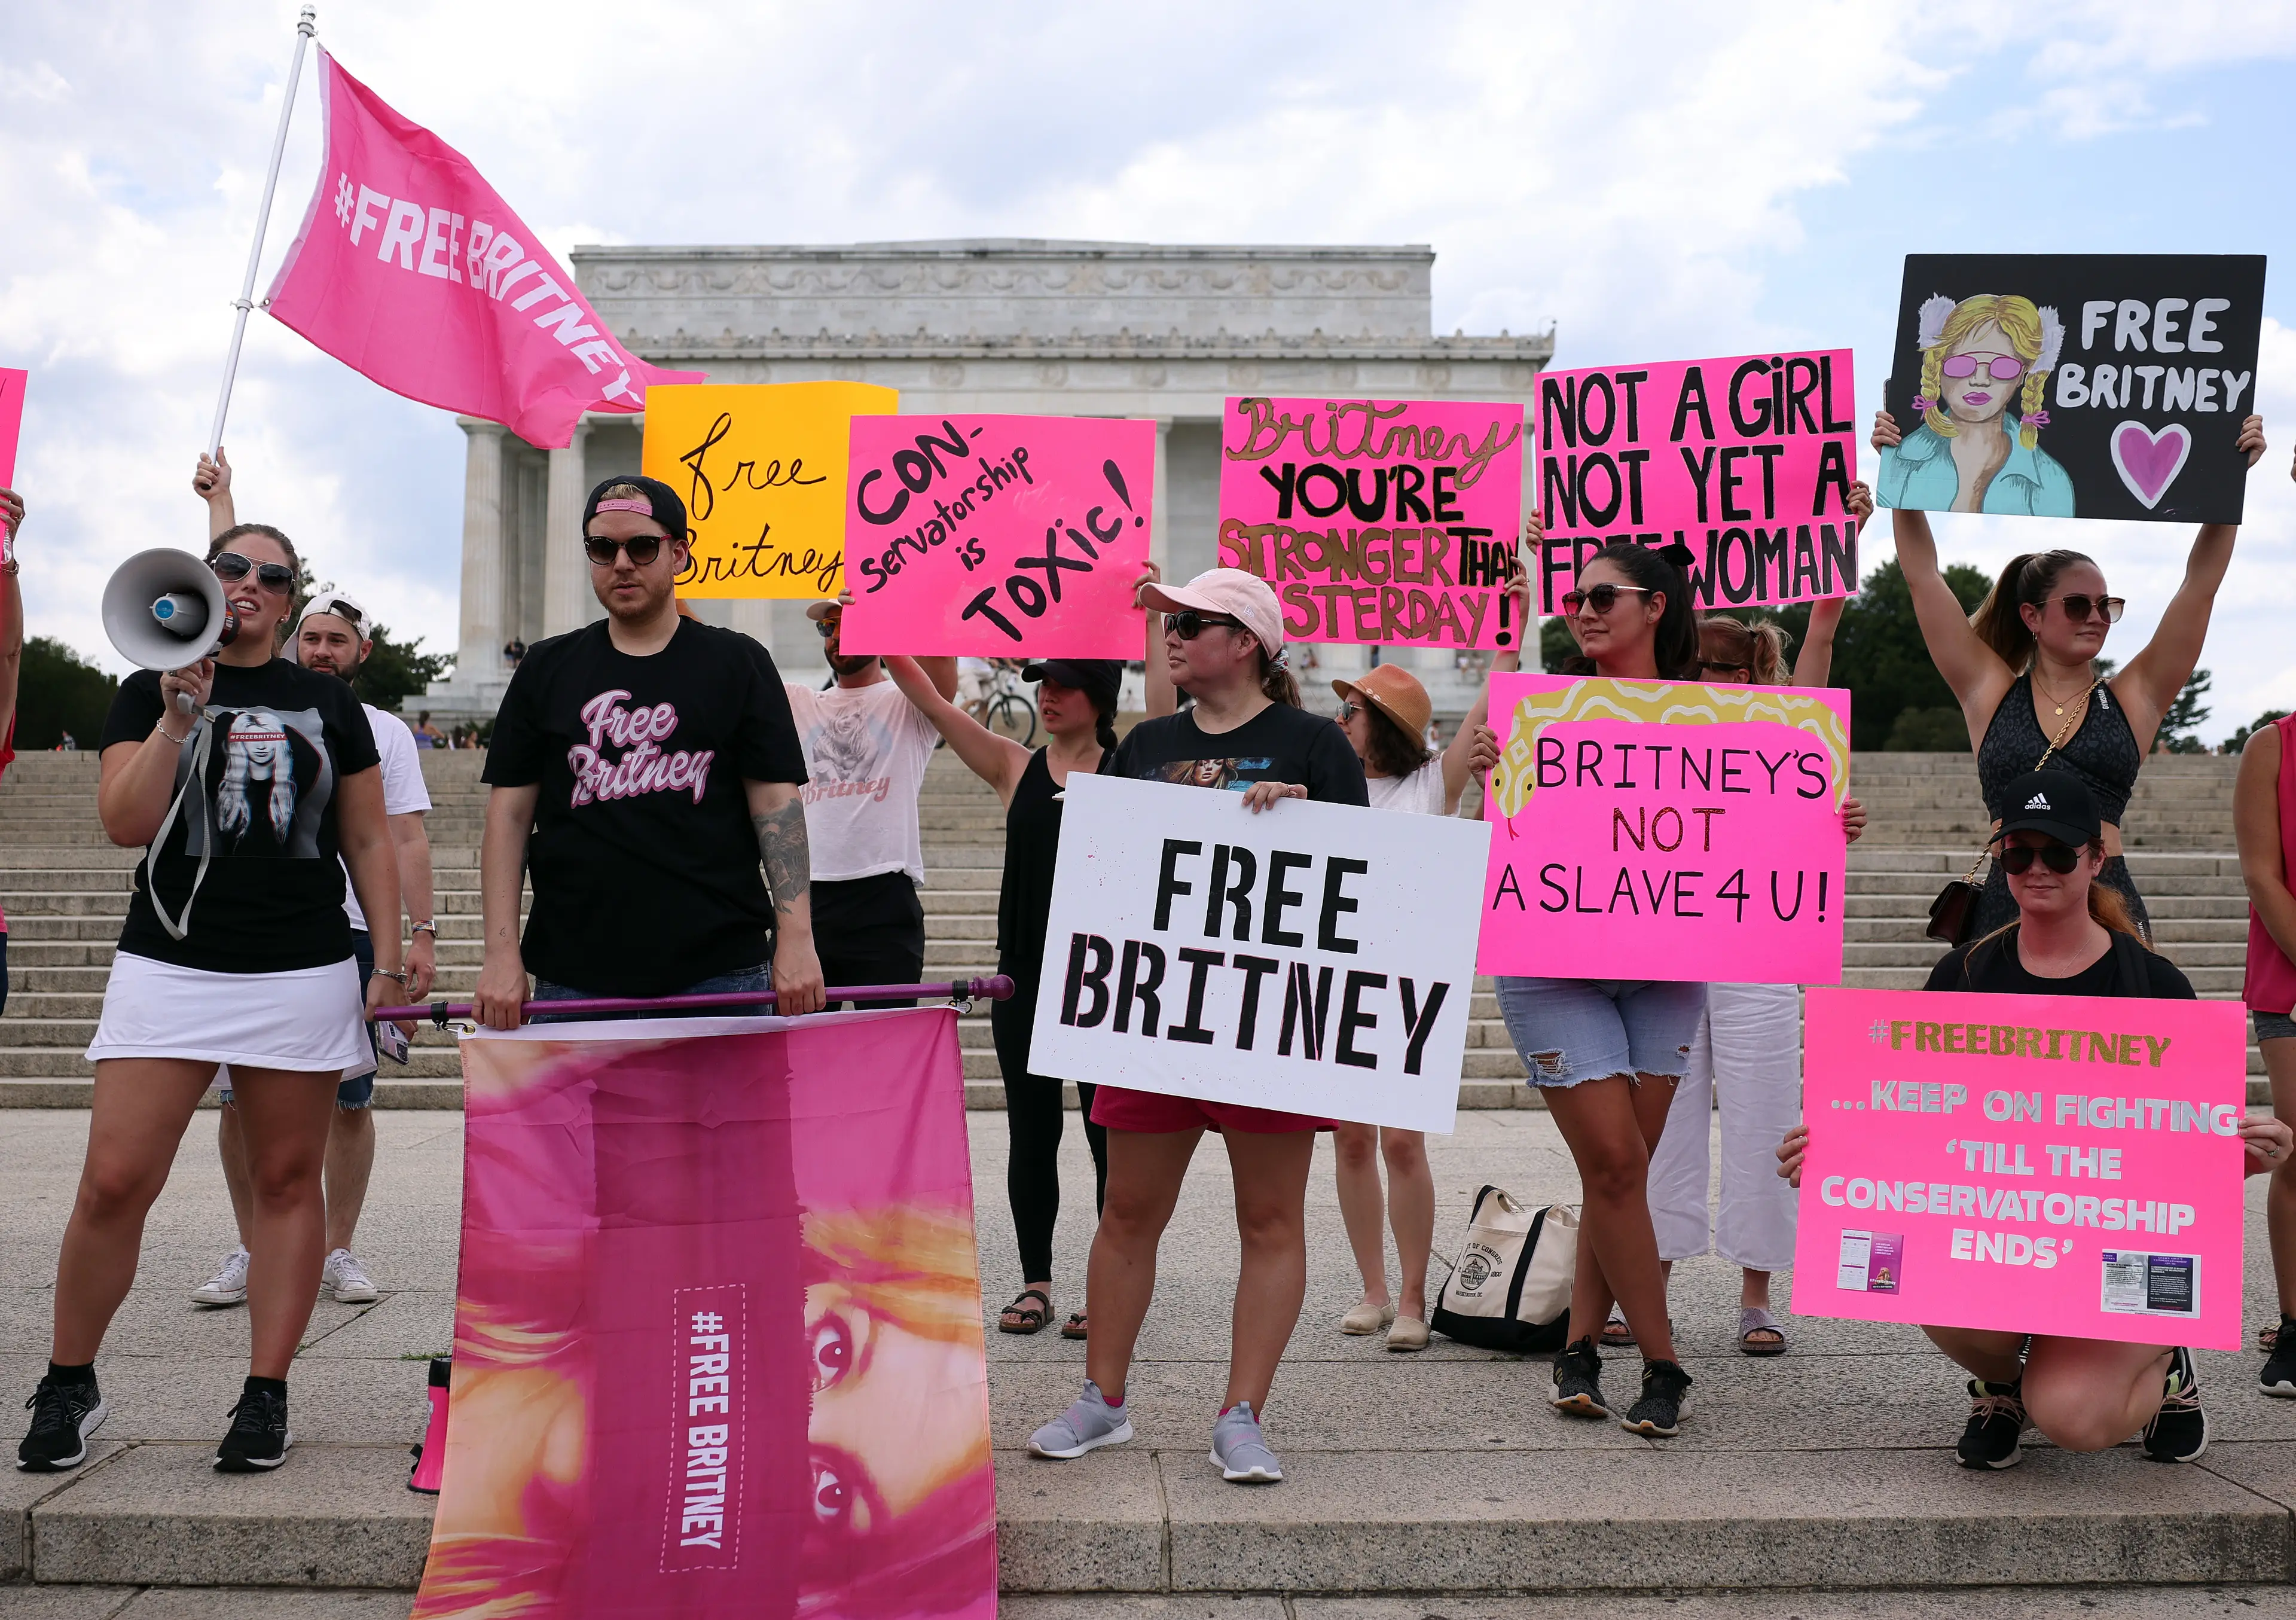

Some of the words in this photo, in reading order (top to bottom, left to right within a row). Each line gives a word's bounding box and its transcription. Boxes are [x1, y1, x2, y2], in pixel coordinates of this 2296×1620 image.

[2081, 298, 2231, 353] FREE
[1541, 370, 1648, 450] NOT
[1669, 366, 1716, 442] A
[2056, 363, 2251, 412] BRITNEY
[1259, 463, 1465, 523] YOU'RE
[1543, 450, 1650, 530] NOT
[1679, 444, 1784, 523] YET
[1812, 441, 1859, 517] A
[955, 537, 987, 572] is
[1218, 518, 1454, 587] STRONGER
[580, 689, 679, 751] Free
[2097, 689, 2109, 709] GYMSHARK
[567, 740, 715, 810] Britney
[1537, 737, 1827, 799] BRITNEY'S
[1613, 807, 1726, 852] NOT
[1153, 838, 1369, 954] FREE
[1492, 864, 1526, 911] A
[1539, 864, 1703, 917] SLAVE
[1715, 869, 1750, 923] 4
[2137, 922, 2147, 943] SHARK
[1059, 932, 1451, 1075] BRITNEY
[1868, 1019, 2172, 1067] #FREEBRITNEY
[1983, 1090, 2042, 1123] ON
[2055, 1094, 2239, 1137] FIGHTING
[2045, 1145, 2122, 1180] THE
[1821, 1176, 2196, 1236] CONSERVATORSHIP
[1481, 1244, 1503, 1265] CONGRESS
[689, 1311, 729, 1417] #FREE
[680, 1424, 728, 1549] BRITNEY
